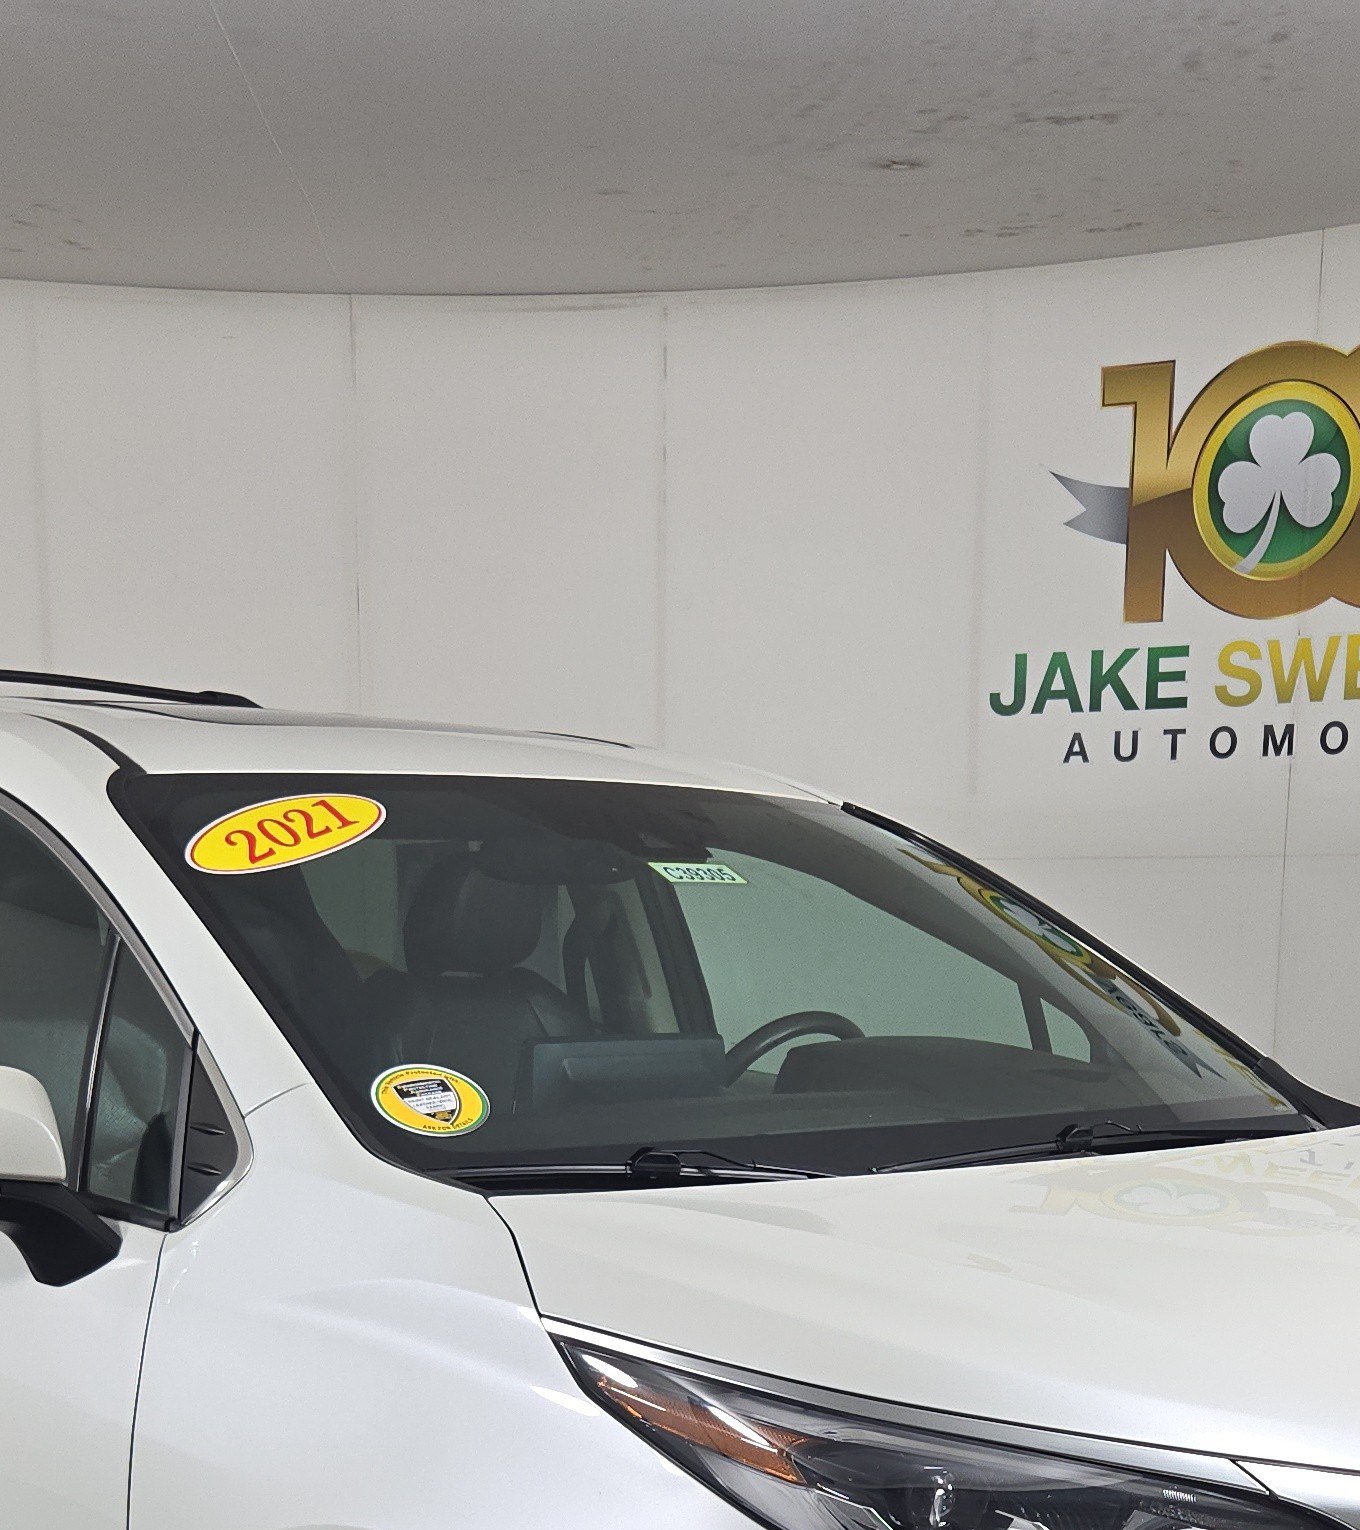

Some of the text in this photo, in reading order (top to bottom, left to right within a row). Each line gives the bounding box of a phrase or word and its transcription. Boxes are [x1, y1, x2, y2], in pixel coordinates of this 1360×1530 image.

[989, 645, 1191, 716] JAKE
[224, 799, 359, 864] 2021
[663, 866, 736, 881] C39305
